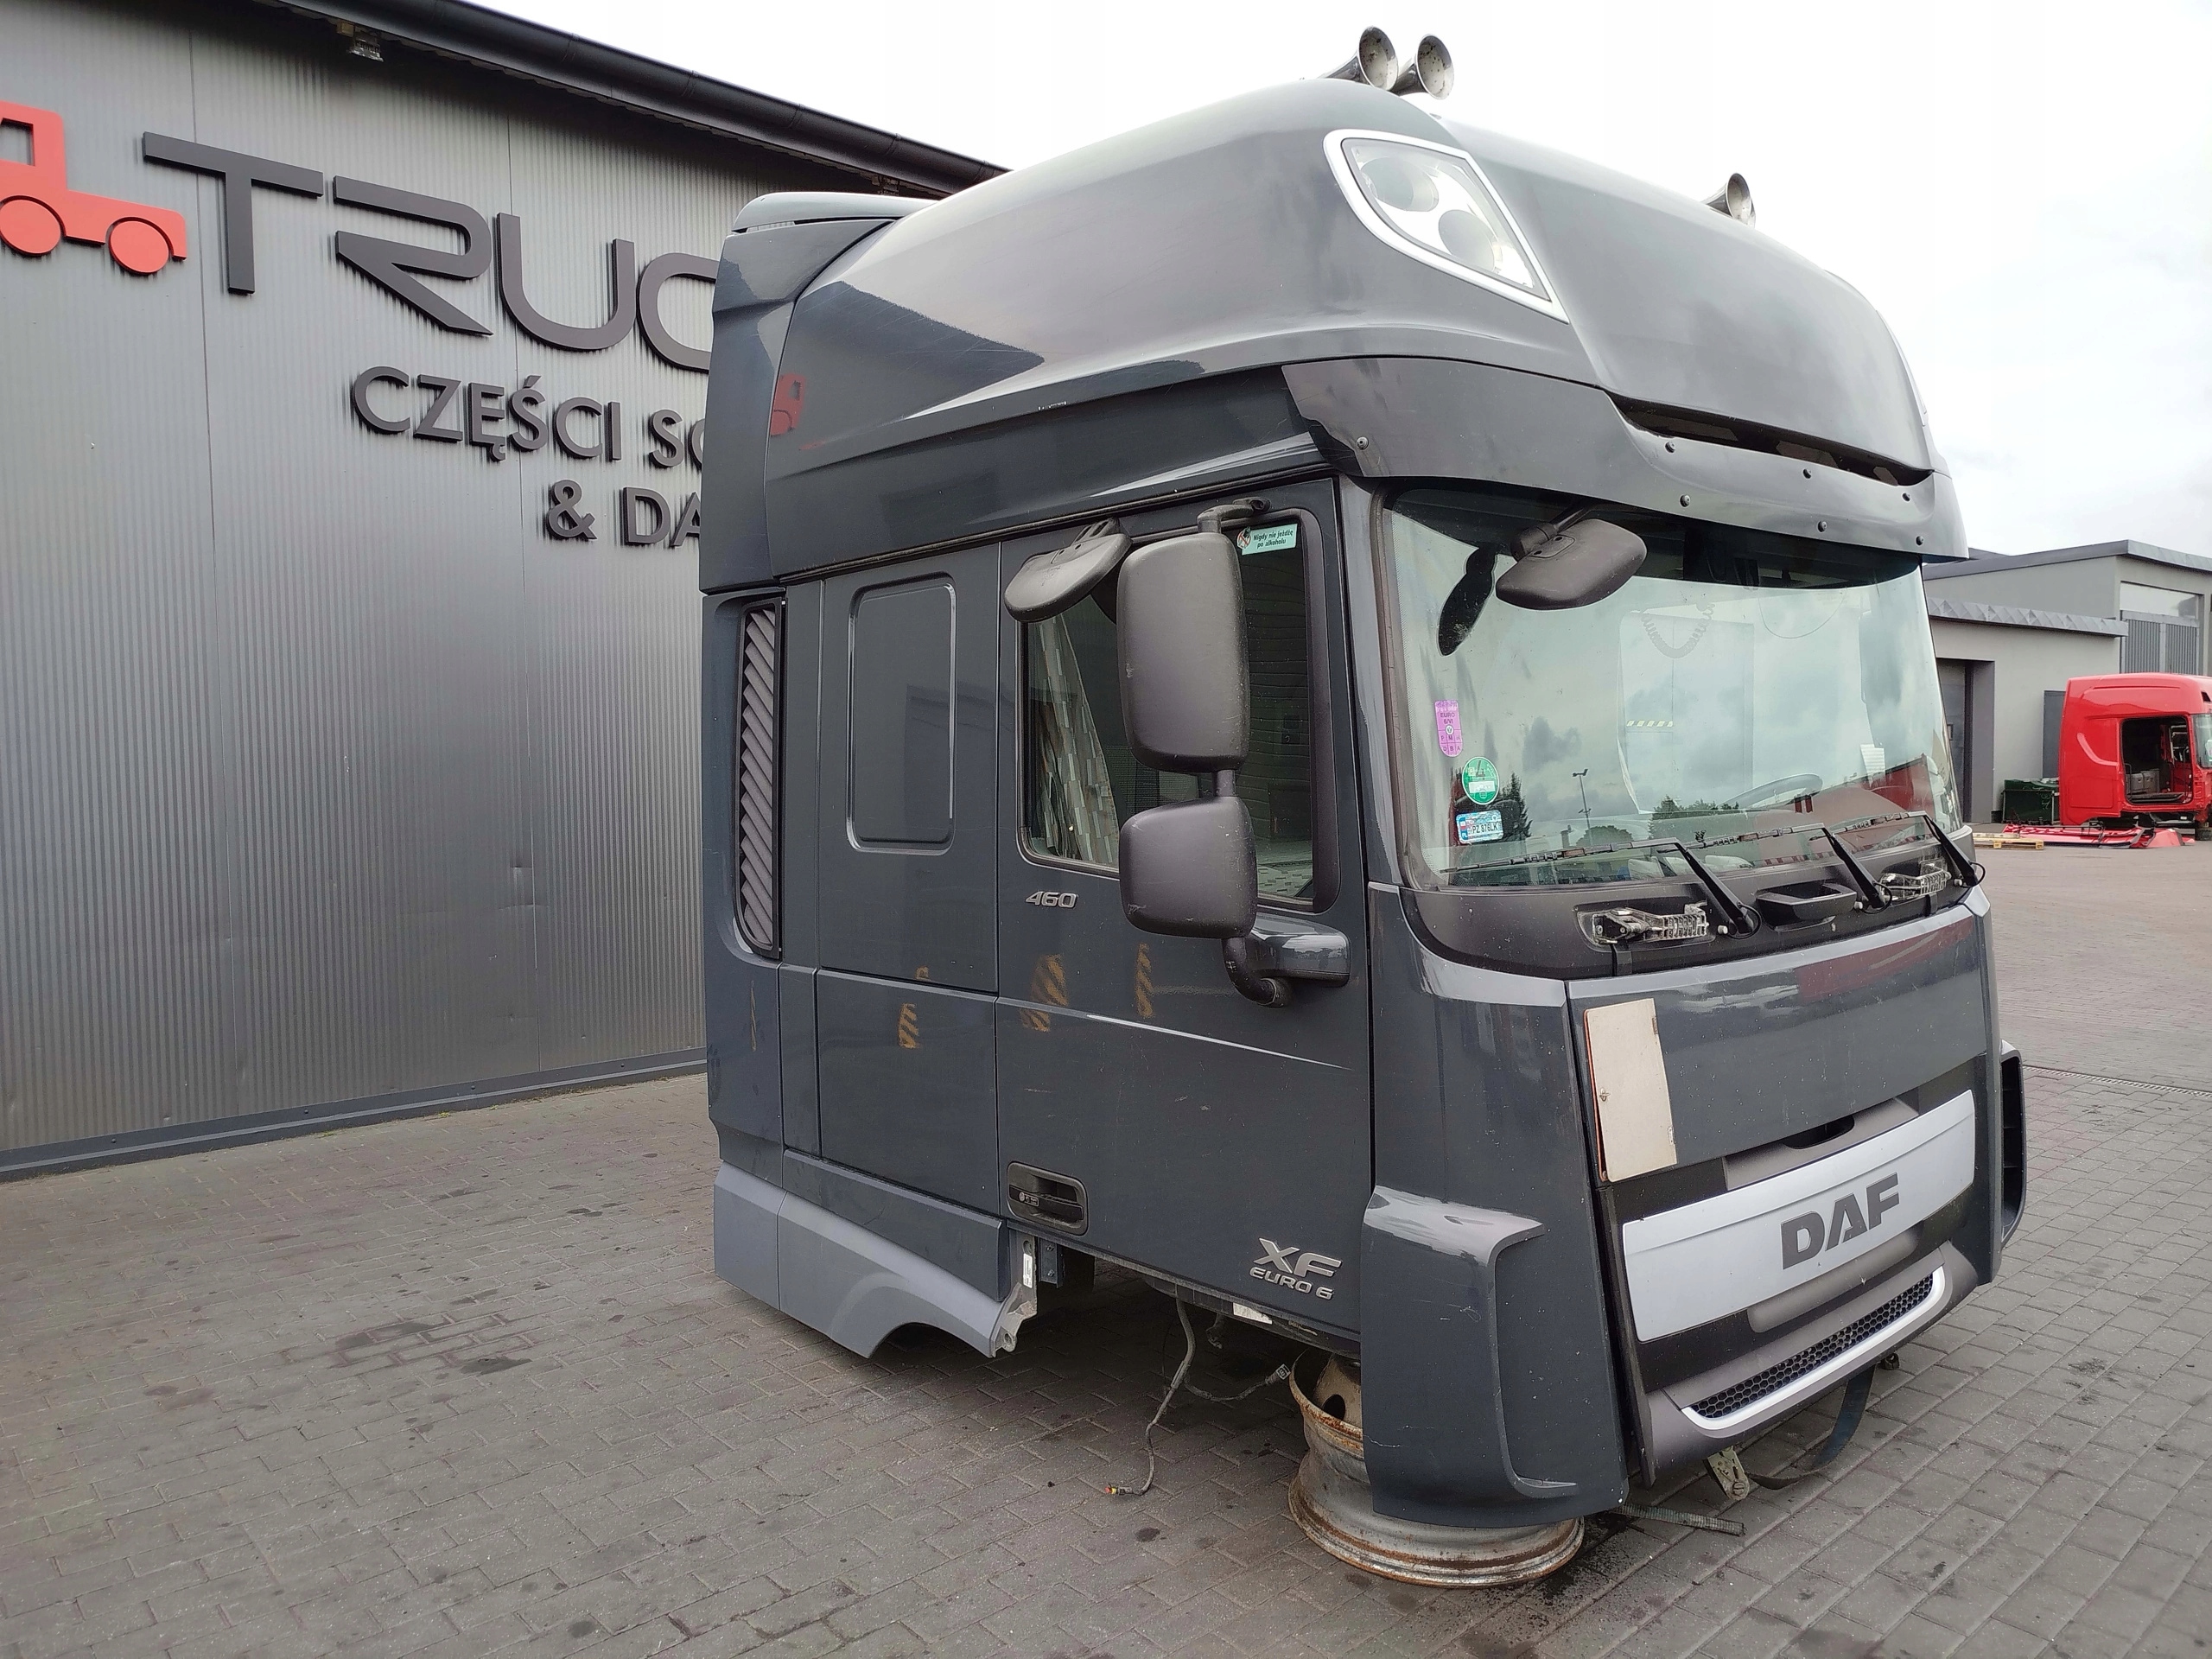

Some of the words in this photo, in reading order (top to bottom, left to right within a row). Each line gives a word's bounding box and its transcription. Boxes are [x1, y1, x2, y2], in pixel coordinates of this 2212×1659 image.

[352, 365, 622, 461] CZĘŚCI
[547, 479, 598, 540] &
[1253, 533, 1268, 542] Nigdy
[1265, 538, 1286, 547] alkoholu
[1025, 891, 1077, 908] 460
[1780, 1172, 1900, 1270] DAF
[1253, 1237, 1342, 1278] XF
[1249, 1266, 1313, 1294] EURO
[1315, 1286, 1334, 1300] 6
